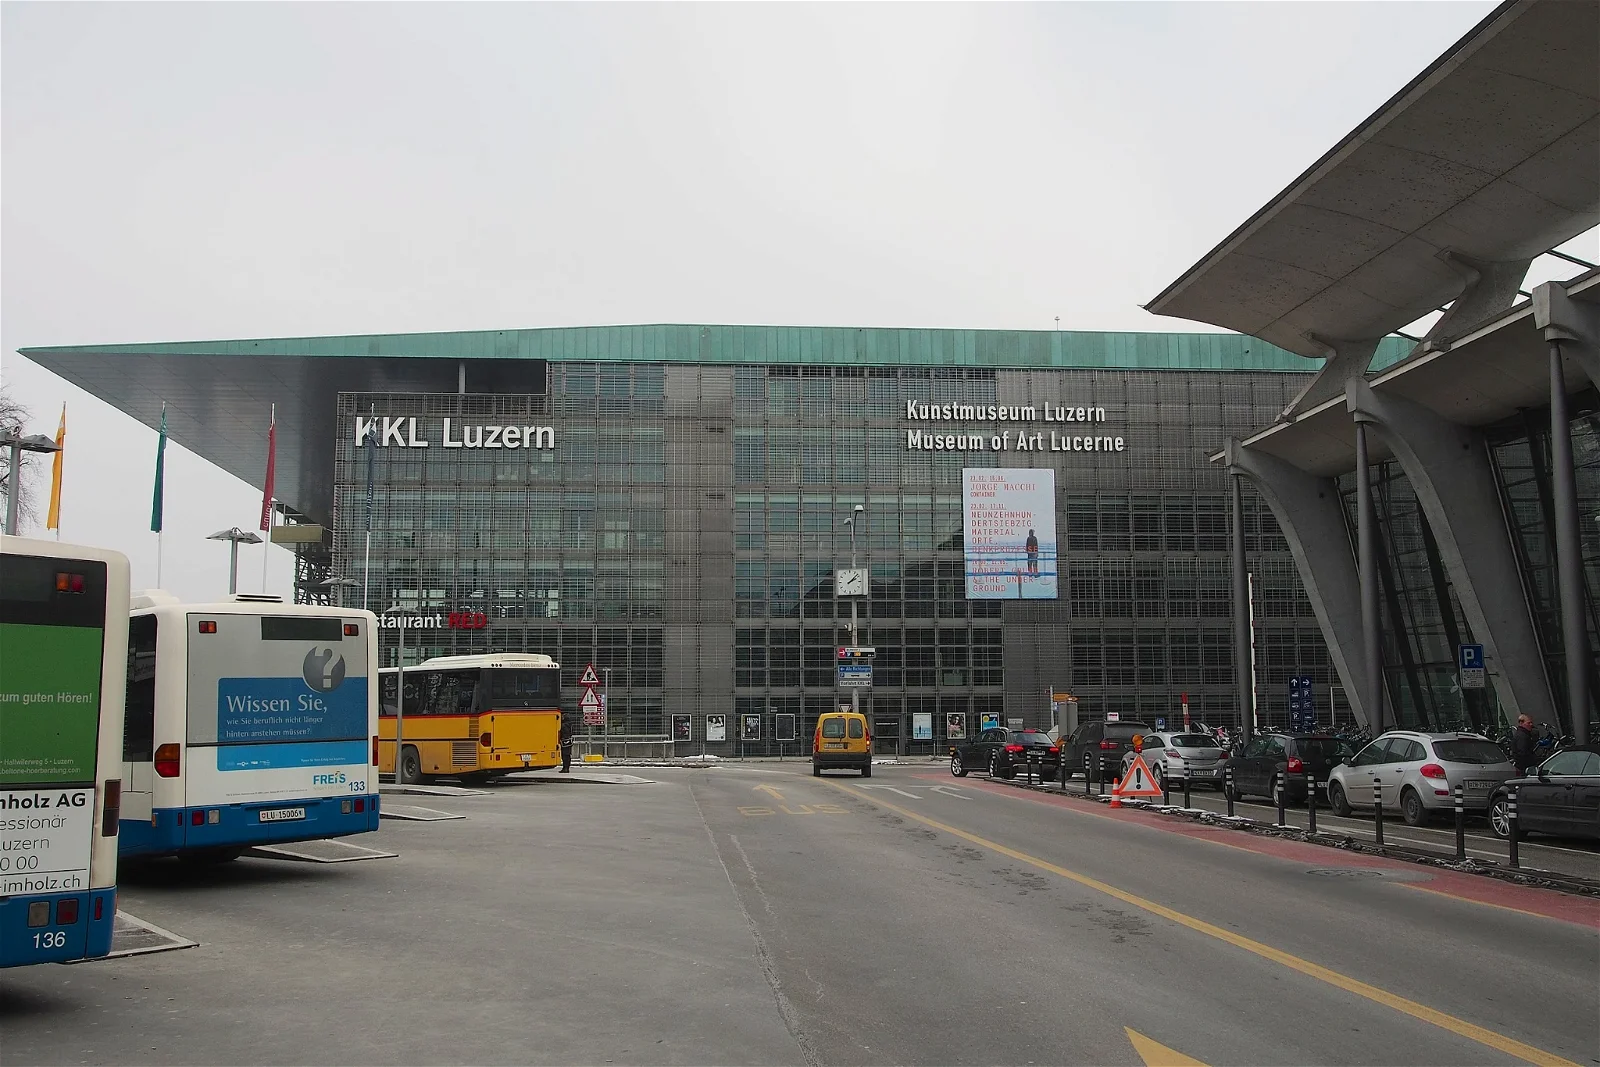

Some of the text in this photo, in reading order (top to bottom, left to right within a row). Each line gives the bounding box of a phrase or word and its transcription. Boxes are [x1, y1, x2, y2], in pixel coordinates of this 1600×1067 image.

[907, 400, 1105, 422] Kunstmuseum Luzern
[355, 416, 555, 448] KKL Luzern
[907, 429, 1124, 452] Museum of Art Lucerne
[971, 483, 1036, 491] JORGE MACCHI
[984, 576, 1000, 584] THE
[973, 584, 1006, 592] GROUND
[448, 612, 488, 629] RED
[23, 692, 54, 705] guten
[57, 692, 93, 703] Hören!
[226, 694, 328, 714] Wissen Sie,
[253, 716, 283, 724] beruflich
[303, 716, 323, 724] länger
[226, 728, 311, 738] hinten anstehen müssen?
[348, 780, 365, 792] 133
[56, 792, 86, 808] AG
[737, 804, 850, 816] BUS
[0, 837, 50, 851] uzern
[16, 855, 38, 870] 00
[32, 931, 66, 949] 136
